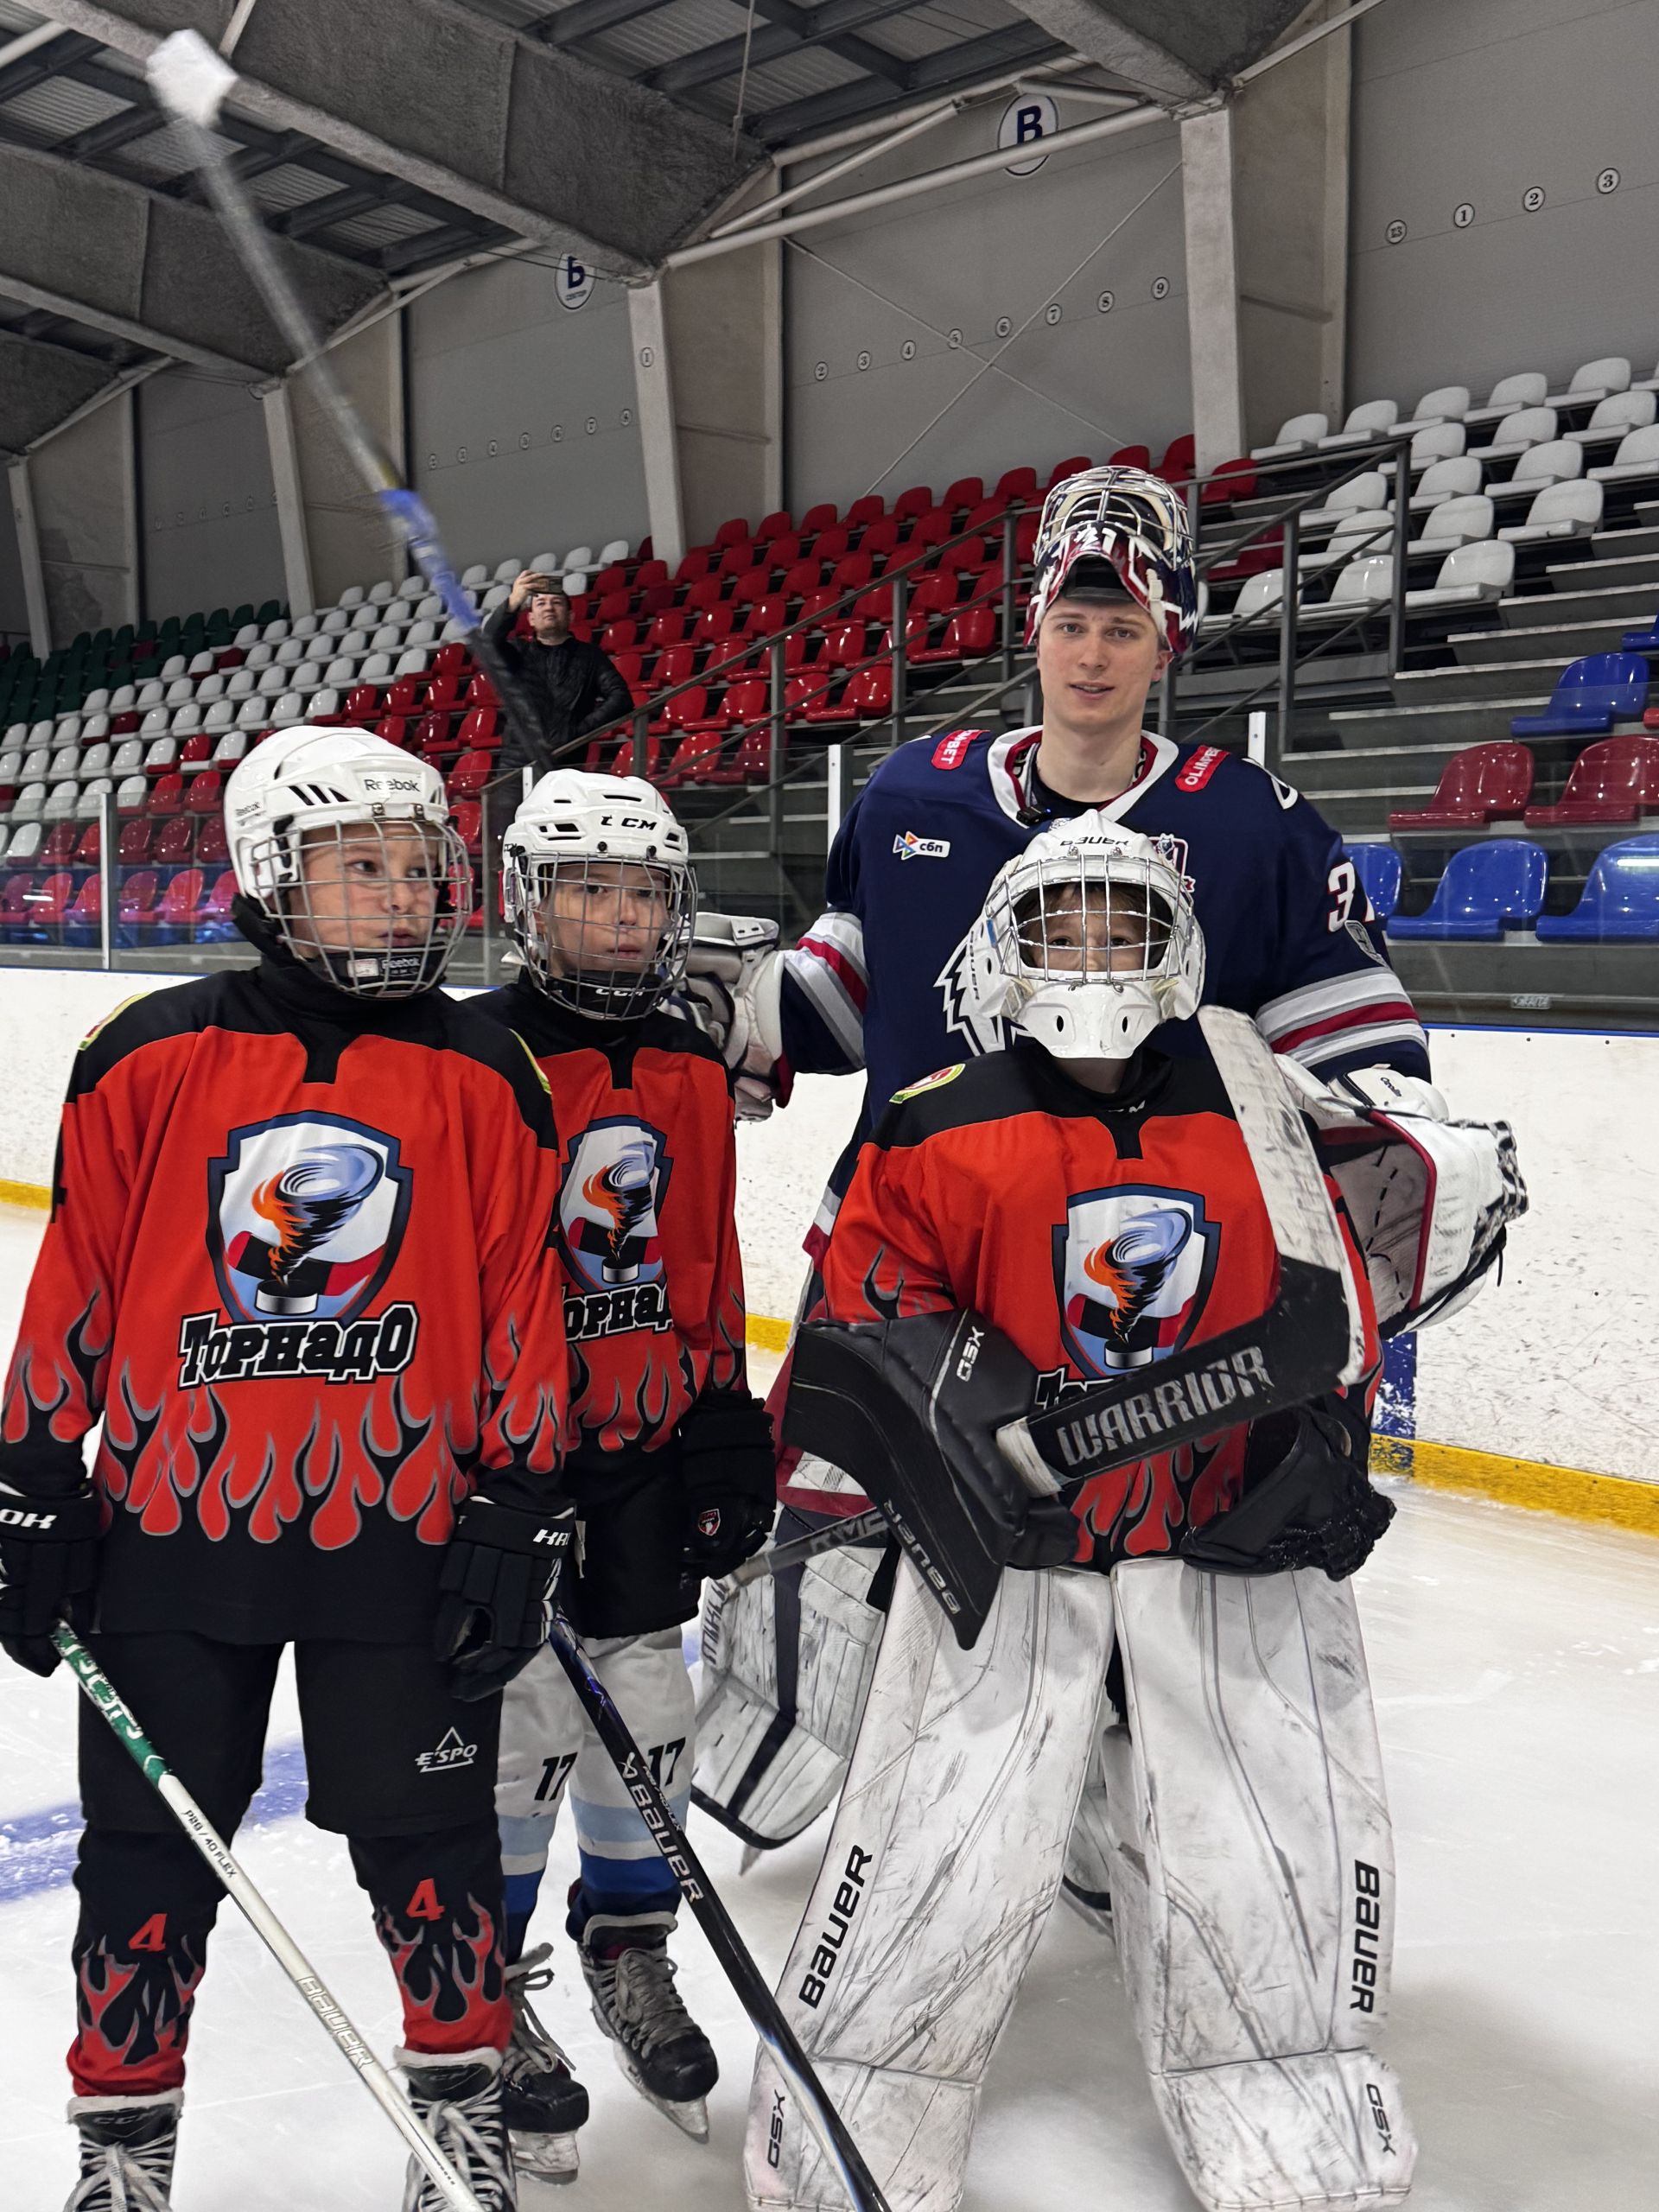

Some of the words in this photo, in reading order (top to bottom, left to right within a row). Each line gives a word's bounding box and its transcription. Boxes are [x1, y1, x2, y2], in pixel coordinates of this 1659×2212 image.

[918, 838, 944, 854] сбп
[956, 1325, 985, 1382] GSX
[1055, 1345, 1275, 1467] WARRIOR
[533, 1751, 578, 1802] 17
[647, 1736, 687, 1788] 17
[629, 1783, 704, 1903] BAUER
[127, 1912, 168, 1953] 4
[404, 1877, 447, 1922] 4
[798, 1844, 874, 2011] BAUER
[1349, 1859, 1381, 2014] BAUER
[296, 1975, 375, 2070] BAUER
[766, 2088, 785, 2170] GSX
[1366, 2082, 1397, 2157] GSX
